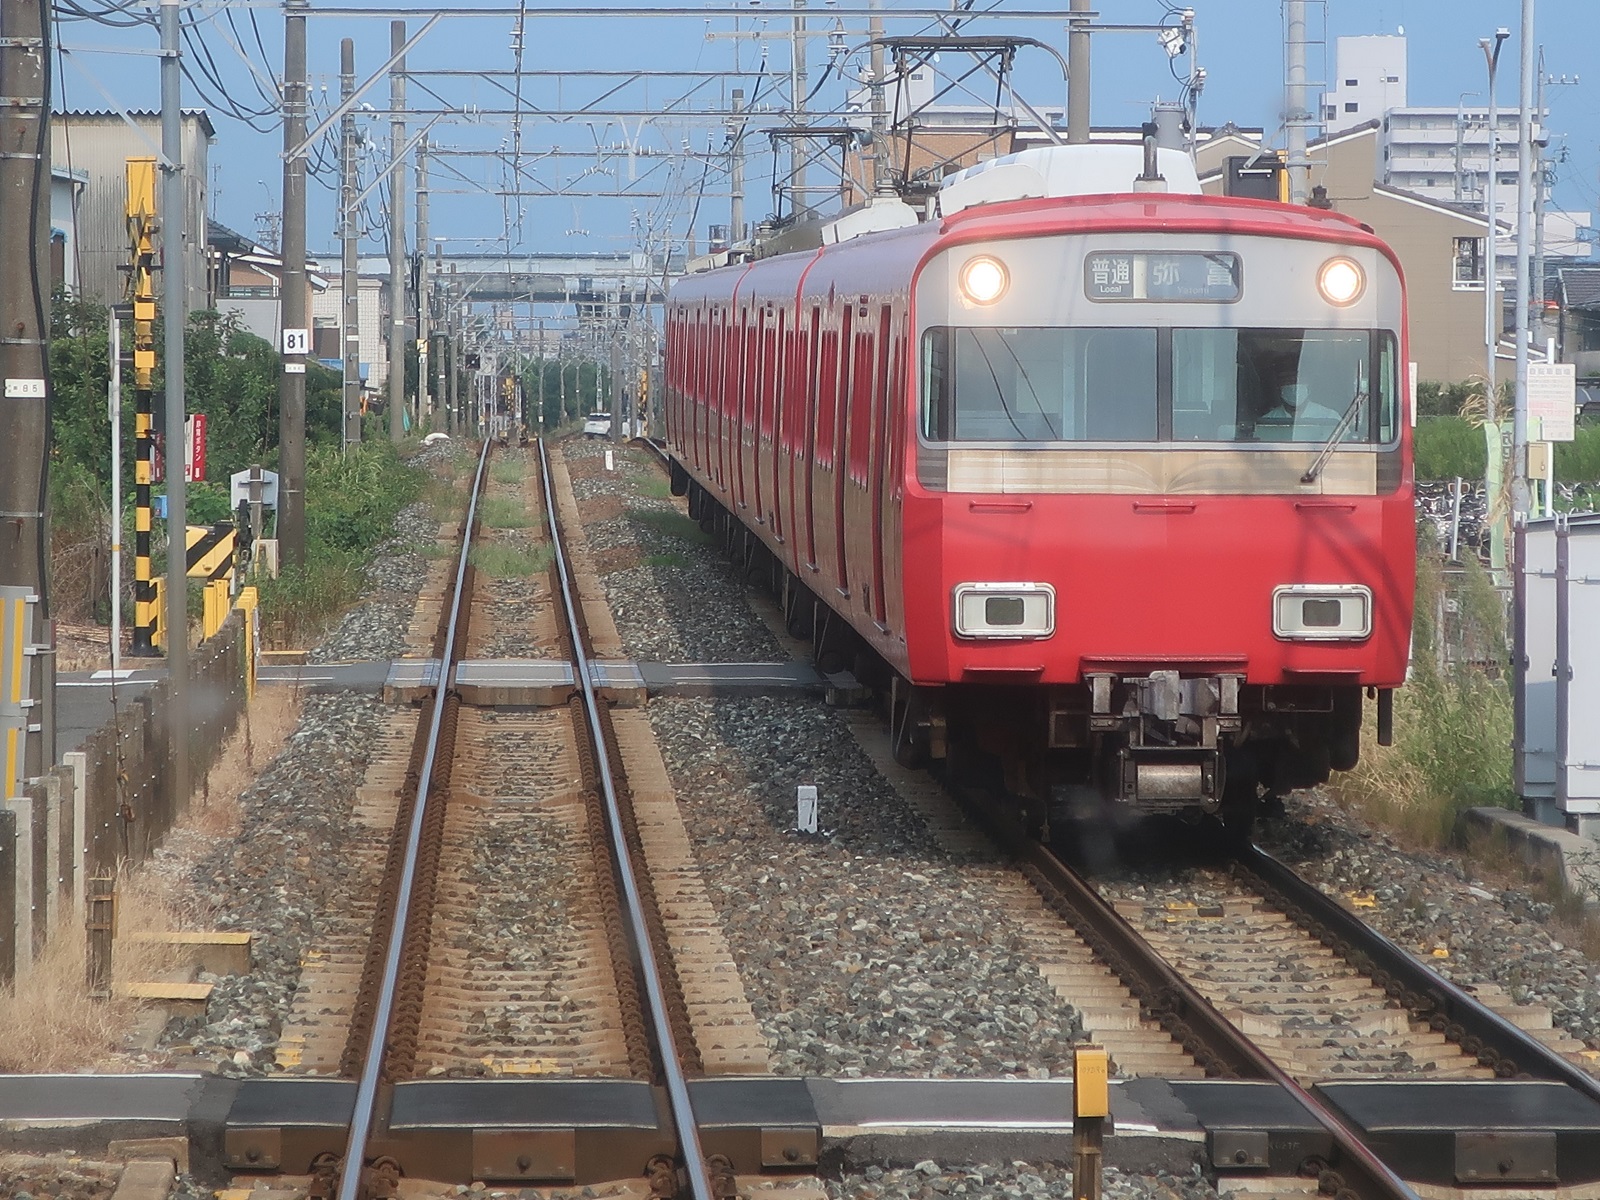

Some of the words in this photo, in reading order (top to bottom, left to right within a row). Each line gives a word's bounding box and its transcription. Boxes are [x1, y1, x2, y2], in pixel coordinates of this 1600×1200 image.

[1091, 257, 1131, 285] 普通
[1099, 285, 1122, 294] Local
[287, 333, 304, 349] 81
